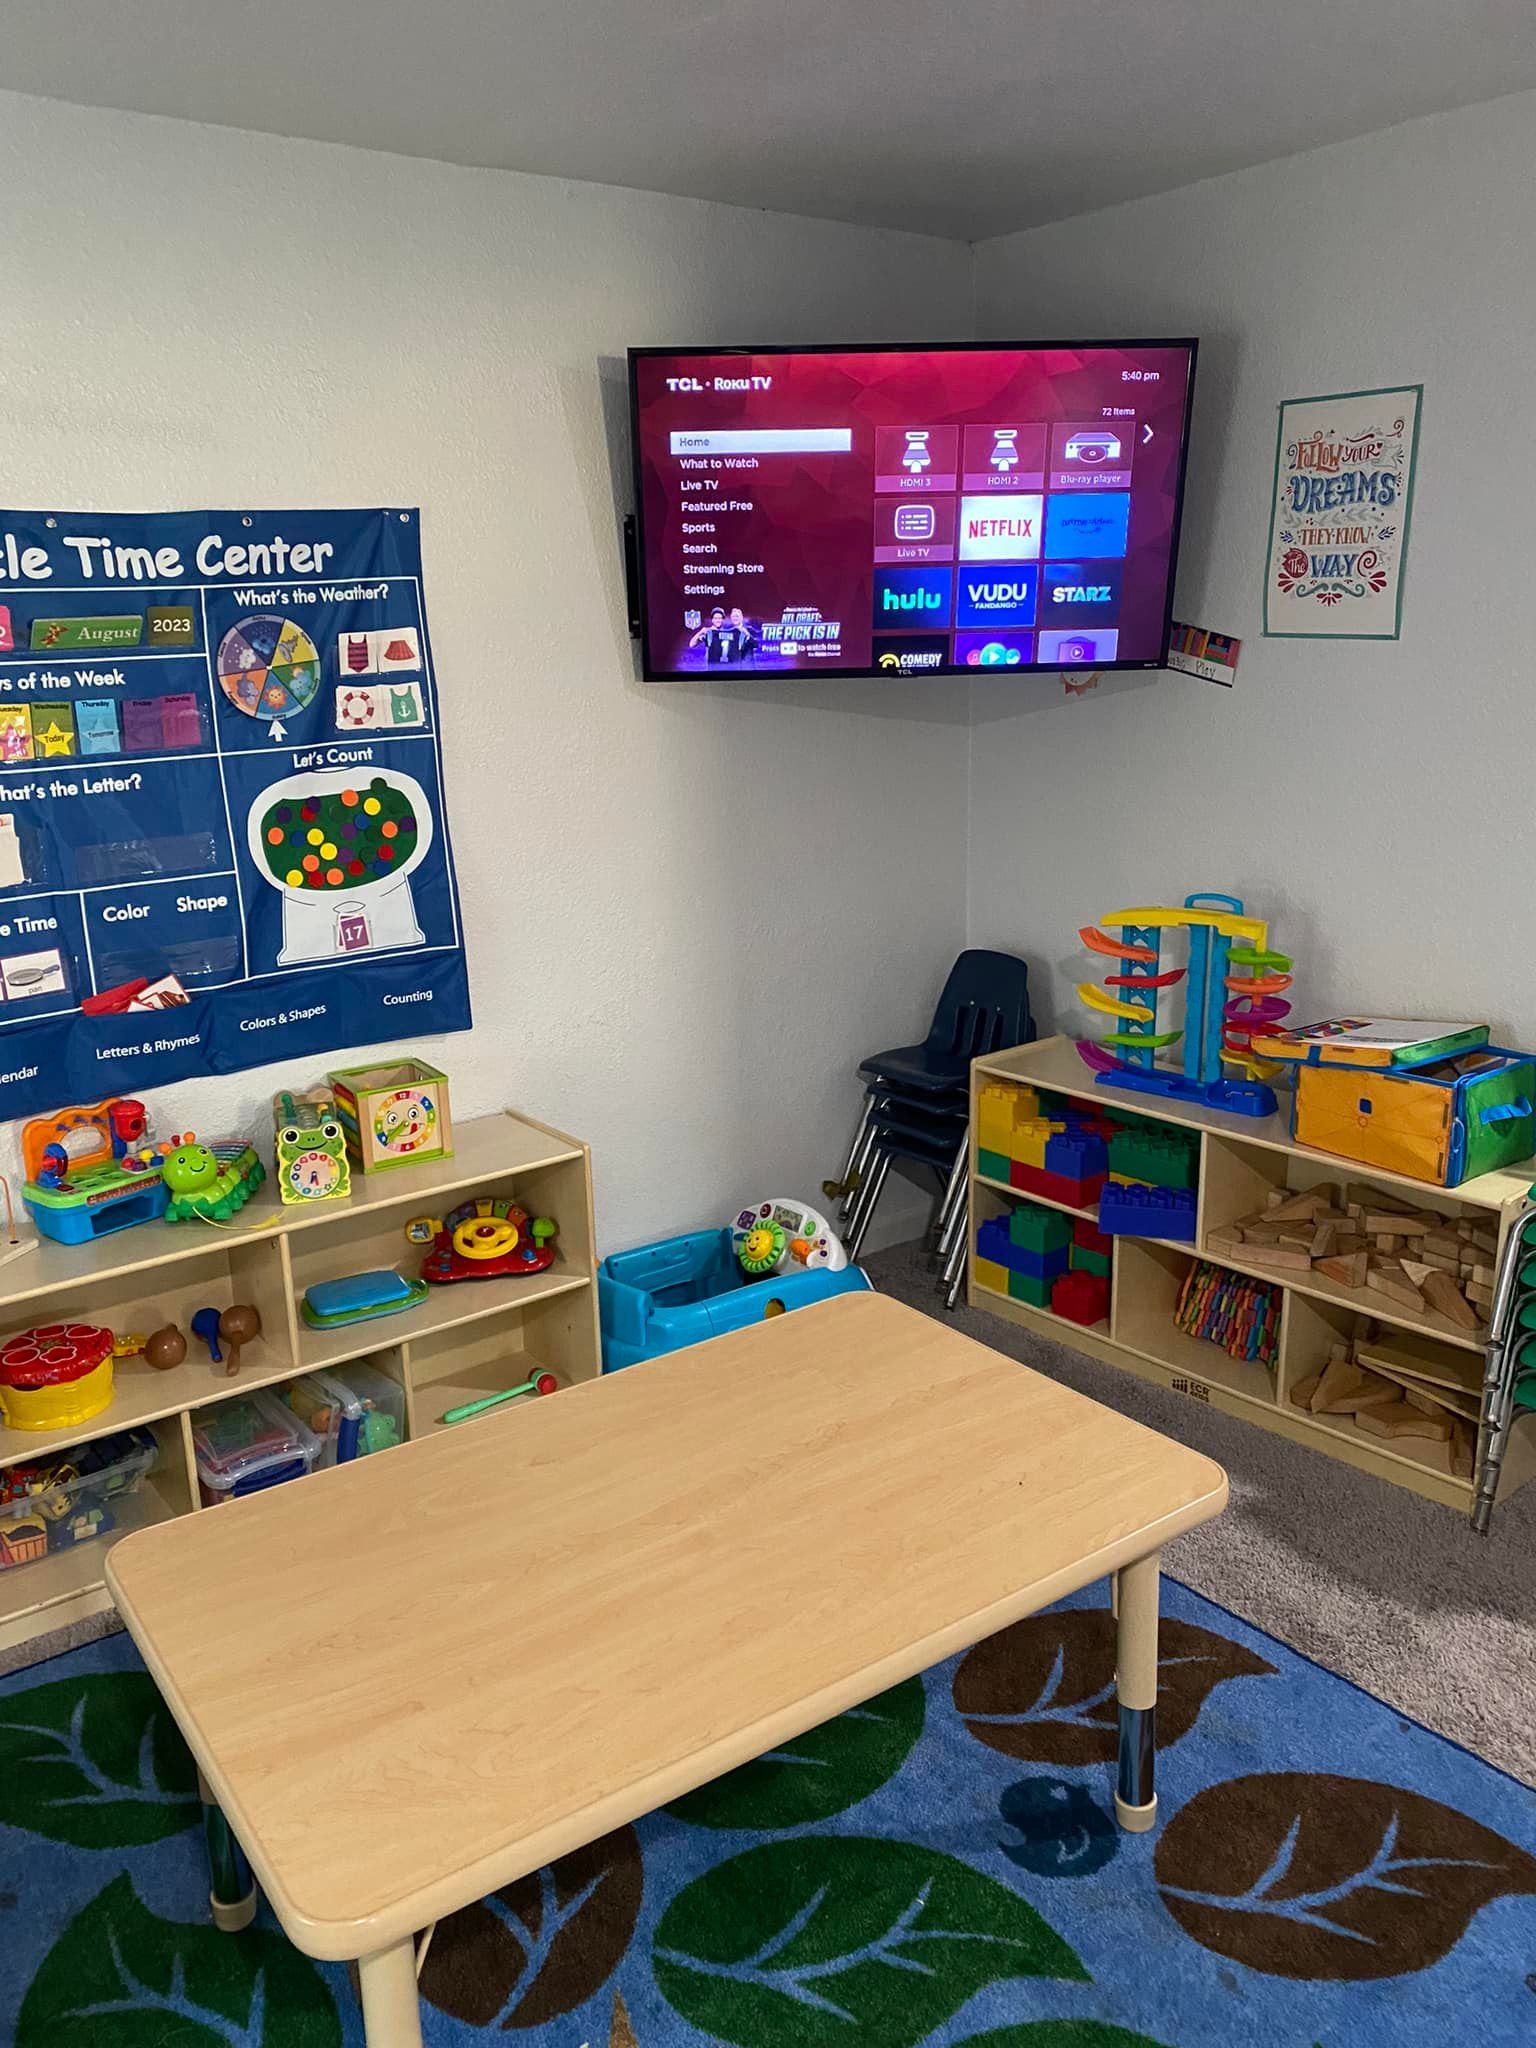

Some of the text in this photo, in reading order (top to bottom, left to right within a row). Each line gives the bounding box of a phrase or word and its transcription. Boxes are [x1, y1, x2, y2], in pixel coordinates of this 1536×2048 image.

[666, 376, 772, 391] TCL Roku TV
[1121, 371, 1160, 382] 5:40 pm
[679, 437, 710, 447] Home
[1342, 442, 1382, 462] YOUR
[680, 457, 759, 469] What to Watch
[680, 480, 719, 491] Live TV
[900, 478, 931, 487] HDMI 3
[987, 476, 1018, 486] HDMI 2
[1060, 473, 1121, 485] Blu-ray player
[1291, 471, 1396, 512] DREAMS
[681, 500, 753, 512] Featured Free
[682, 522, 715, 534] Sports
[969, 519, 1032, 539] NETFLIX
[1301, 527, 1371, 545] THEY KNOW
[683, 543, 717, 553] Search
[897, 548, 930, 557] Live TV
[63, 536, 184, 580] Time
[196, 535, 333, 576] Center
[683, 563, 764, 576] Streaming Store
[1311, 554, 1358, 578] WAY
[233, 583, 389, 607] What's the Weather?
[684, 584, 725, 595] Settings
[968, 583, 1028, 602] VUDU
[1052, 586, 1112, 603] STARZ
[884, 588, 941, 610] hulu
[153, 619, 191, 632] 2023
[762, 625, 840, 641] THE PICK IS IN
[77, 627, 138, 642] August
[900, 653, 942, 666] COMEDY
[17, 672, 37, 689] of
[41, 671, 71, 689] the
[74, 668, 126, 687] Week
[44, 735, 64, 744] Today
[293, 747, 373, 768] Let's Count
[49, 780, 78, 797] the
[83, 773, 141, 794] Letter?
[103, 896, 228, 922] Color Shape
[14, 917, 57, 934] Time
[345, 925, 363, 941] 17
[383, 990, 433, 1005] Counting
[240, 1005, 327, 1031] Colors & Shapes
[96, 1033, 200, 1060] Letters & Rhymes
